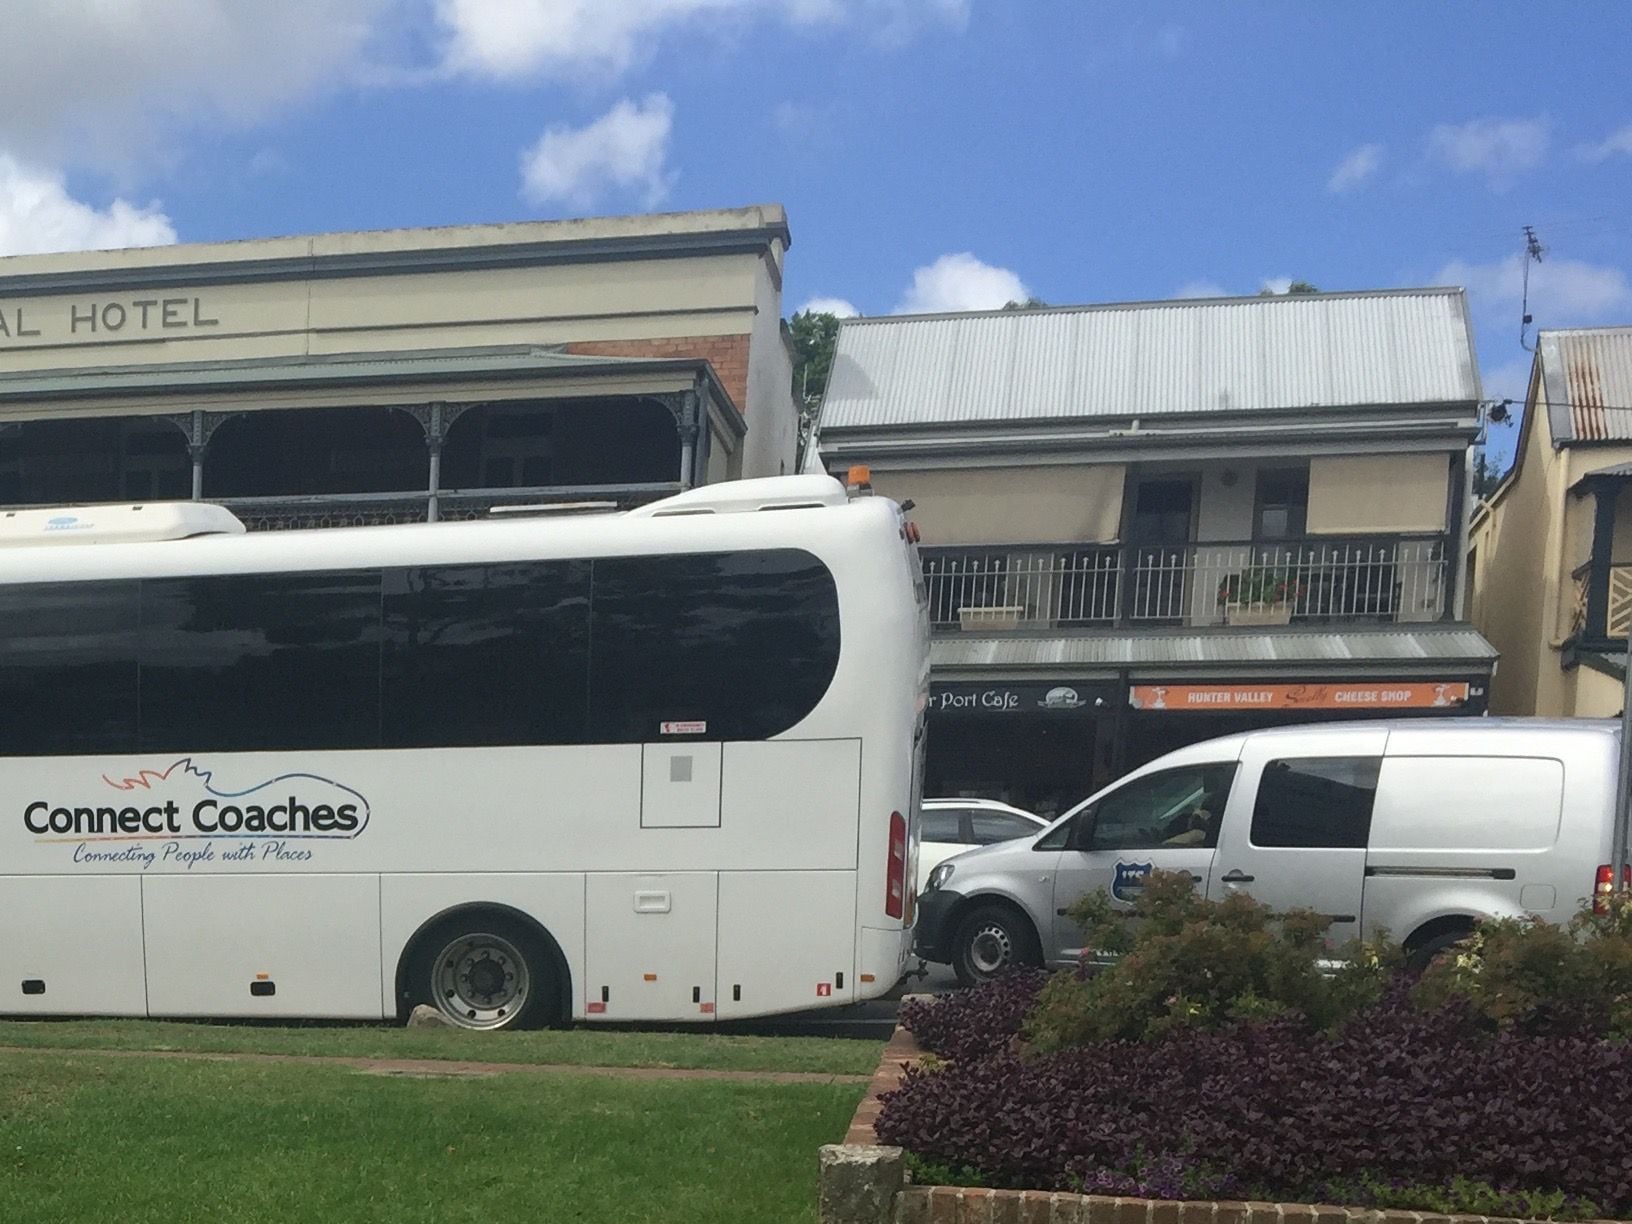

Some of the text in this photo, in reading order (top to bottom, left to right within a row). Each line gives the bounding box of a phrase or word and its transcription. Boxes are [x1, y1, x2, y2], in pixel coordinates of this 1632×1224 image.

[70, 298, 219, 333] HOTEL
[940, 692, 976, 710] Port
[981, 690, 1019, 711] Cafe
[1187, 691, 1231, 703] HUNTER
[1234, 691, 1273, 703] VALLEY
[1334, 691, 1377, 703] CHEESE
[1381, 690, 1412, 702] SHOP
[24, 796, 359, 834] Connect Coaches
[73, 841, 313, 870] Connecting People with Places
